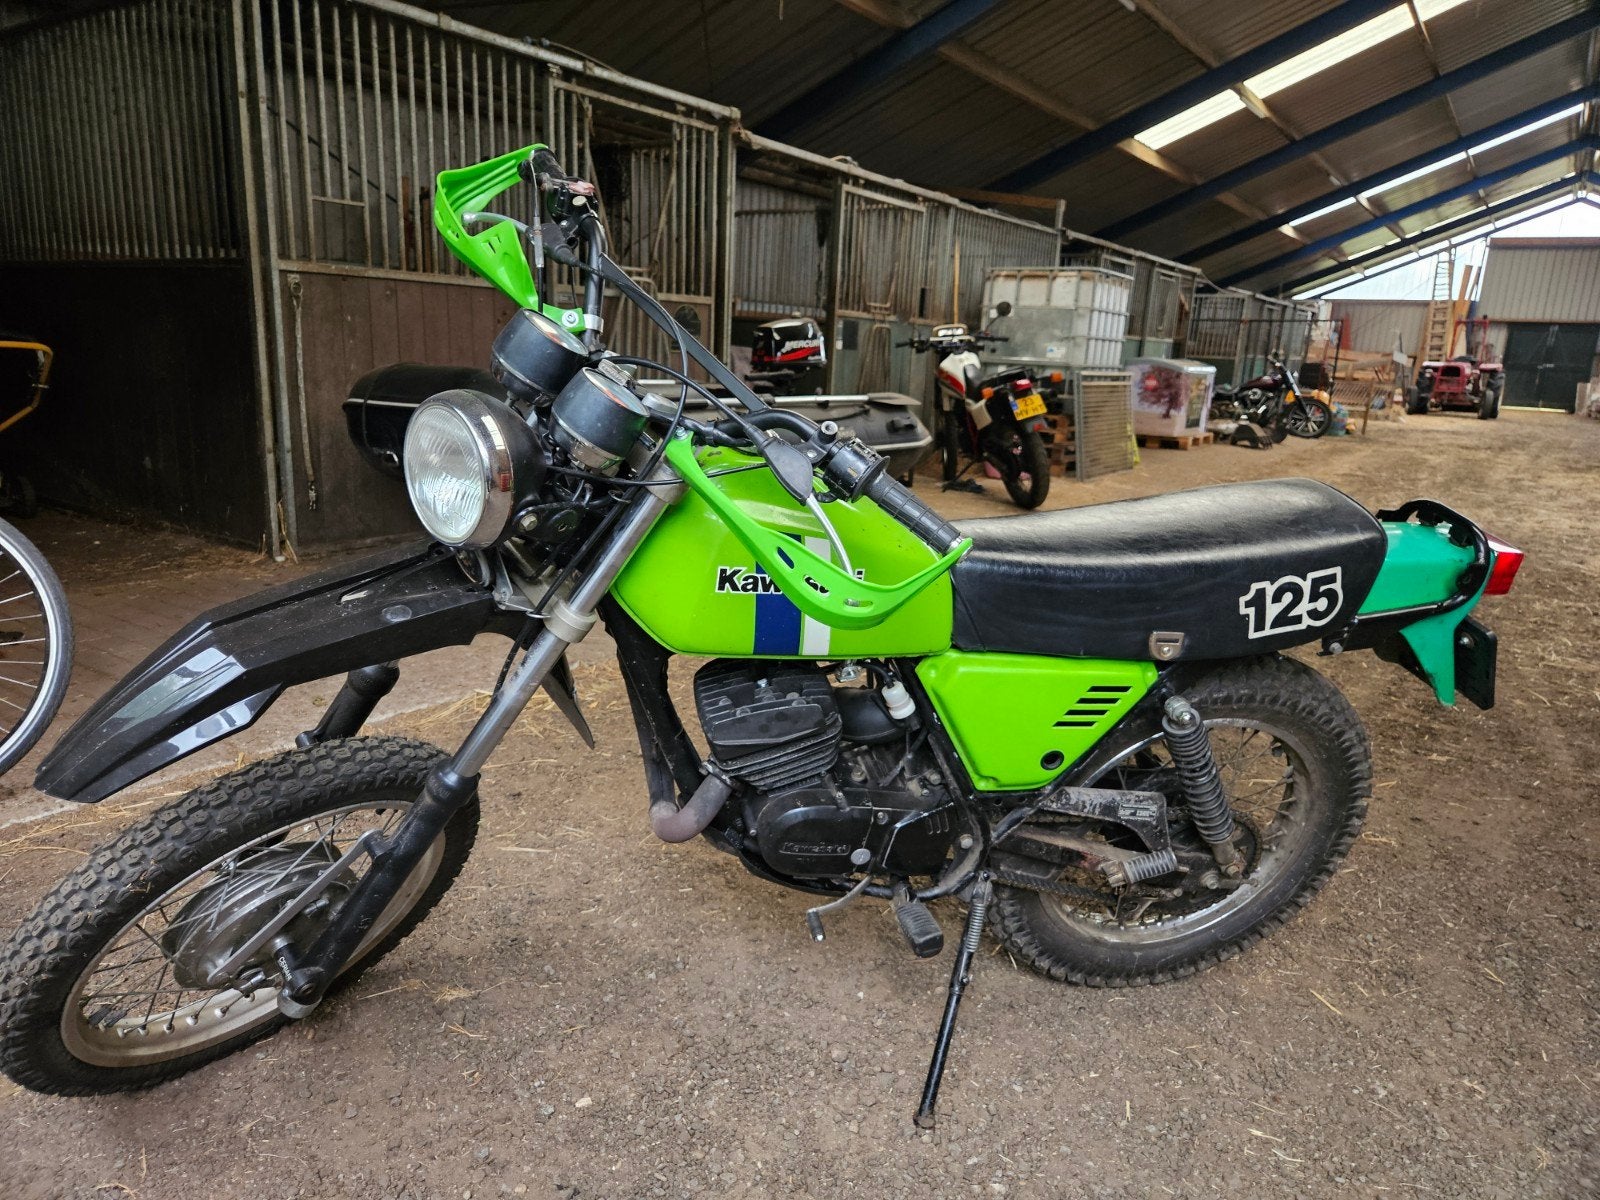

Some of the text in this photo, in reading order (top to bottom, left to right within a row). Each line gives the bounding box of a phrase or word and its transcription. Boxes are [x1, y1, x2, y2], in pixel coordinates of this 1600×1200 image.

[782, 339, 822, 353] MERCUR
[716, 566, 865, 597] Kawi
[1239, 566, 1343, 639] 125
